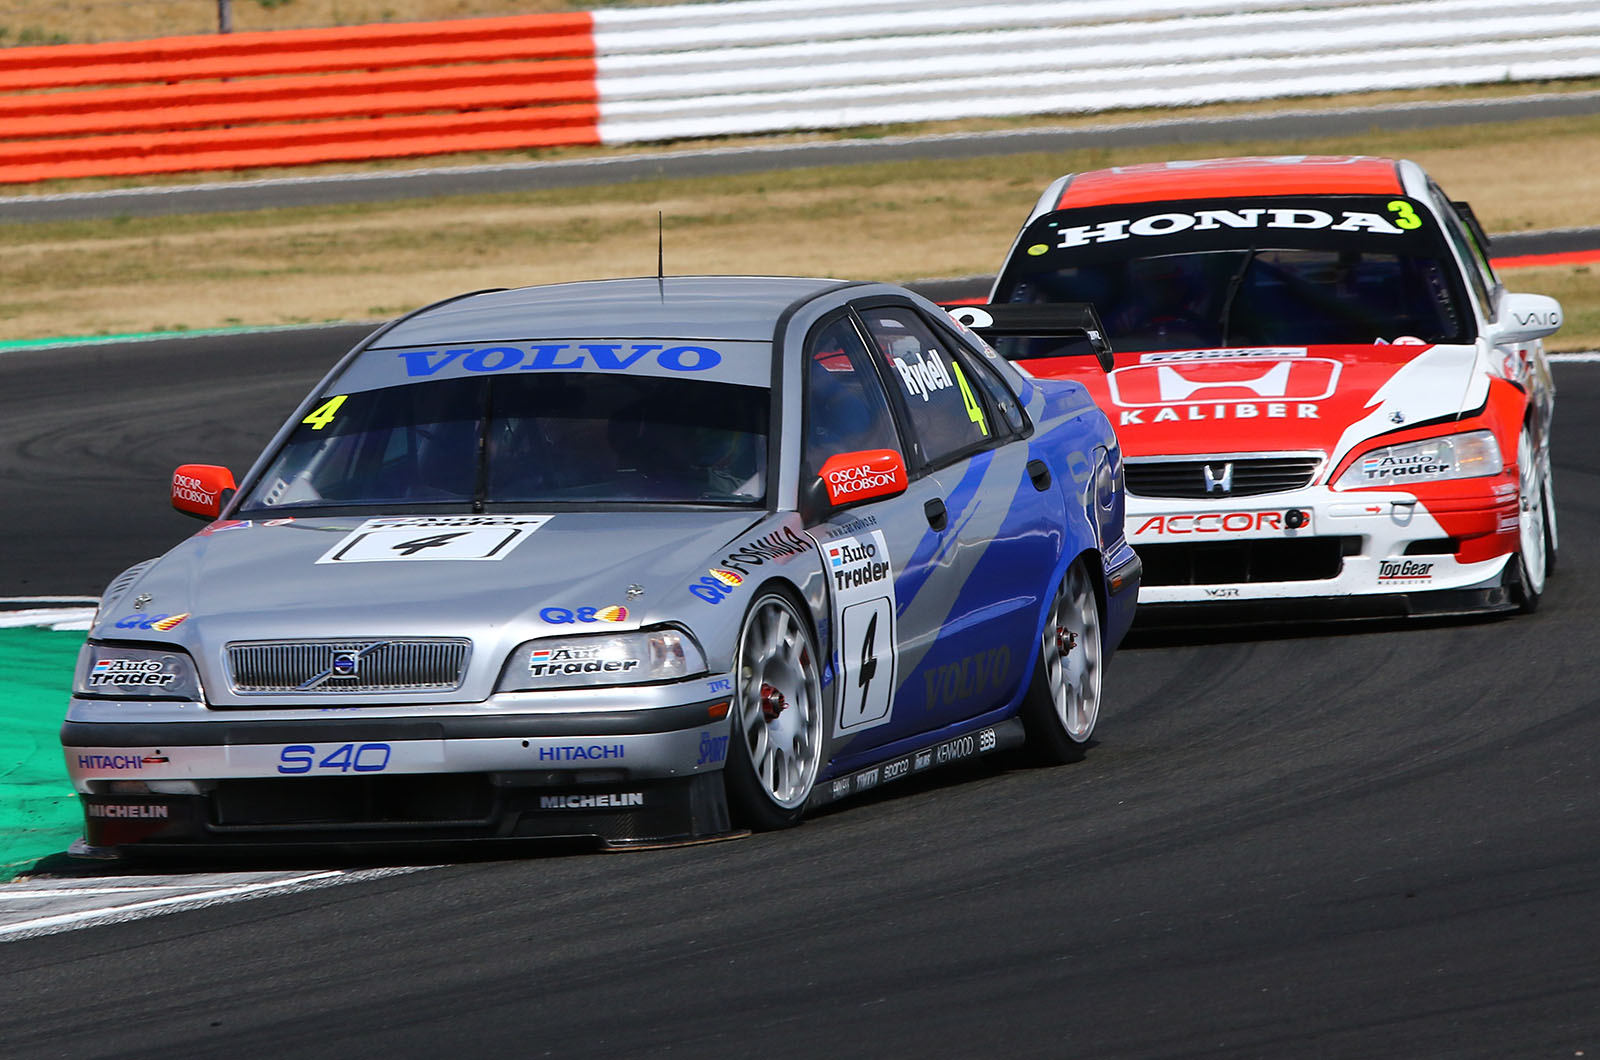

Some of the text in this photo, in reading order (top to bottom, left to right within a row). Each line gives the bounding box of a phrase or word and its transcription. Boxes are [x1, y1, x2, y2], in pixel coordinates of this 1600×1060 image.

[1387, 201, 1422, 230] 3
[1057, 207, 1404, 249] HONDA
[1513, 312, 1559, 326] VAIO
[398, 343, 722, 376] VOLVO
[893, 349, 954, 402] Rydell
[952, 361, 988, 436] 4
[302, 395, 348, 430] 4
[1119, 403, 1320, 426] KALIBER
[1365, 463, 1450, 479] Trader
[1378, 456, 1433, 466] Auto
[173, 473, 201, 490] OSCAR
[829, 465, 872, 484] OSCAR
[832, 472, 897, 498] JACOBSON
[172, 486, 214, 506] JACOBSON
[391, 531, 474, 556] 4
[841, 541, 876, 564] Auto
[835, 560, 889, 592] Trader
[688, 575, 733, 605] Q8
[115, 613, 169, 630] Q8
[540, 606, 597, 625] Q8
[108, 659, 162, 672] Auto
[531, 660, 637, 676] Trader
[858, 609, 878, 716] 4
[90, 672, 174, 687] Trader
[924, 645, 1011, 712] VOLVO
[78, 754, 143, 769] HITACHI
[539, 744, 624, 761] HITACHI
[540, 792, 643, 809] MICHELIN
[88, 804, 168, 818] MICHELIN
